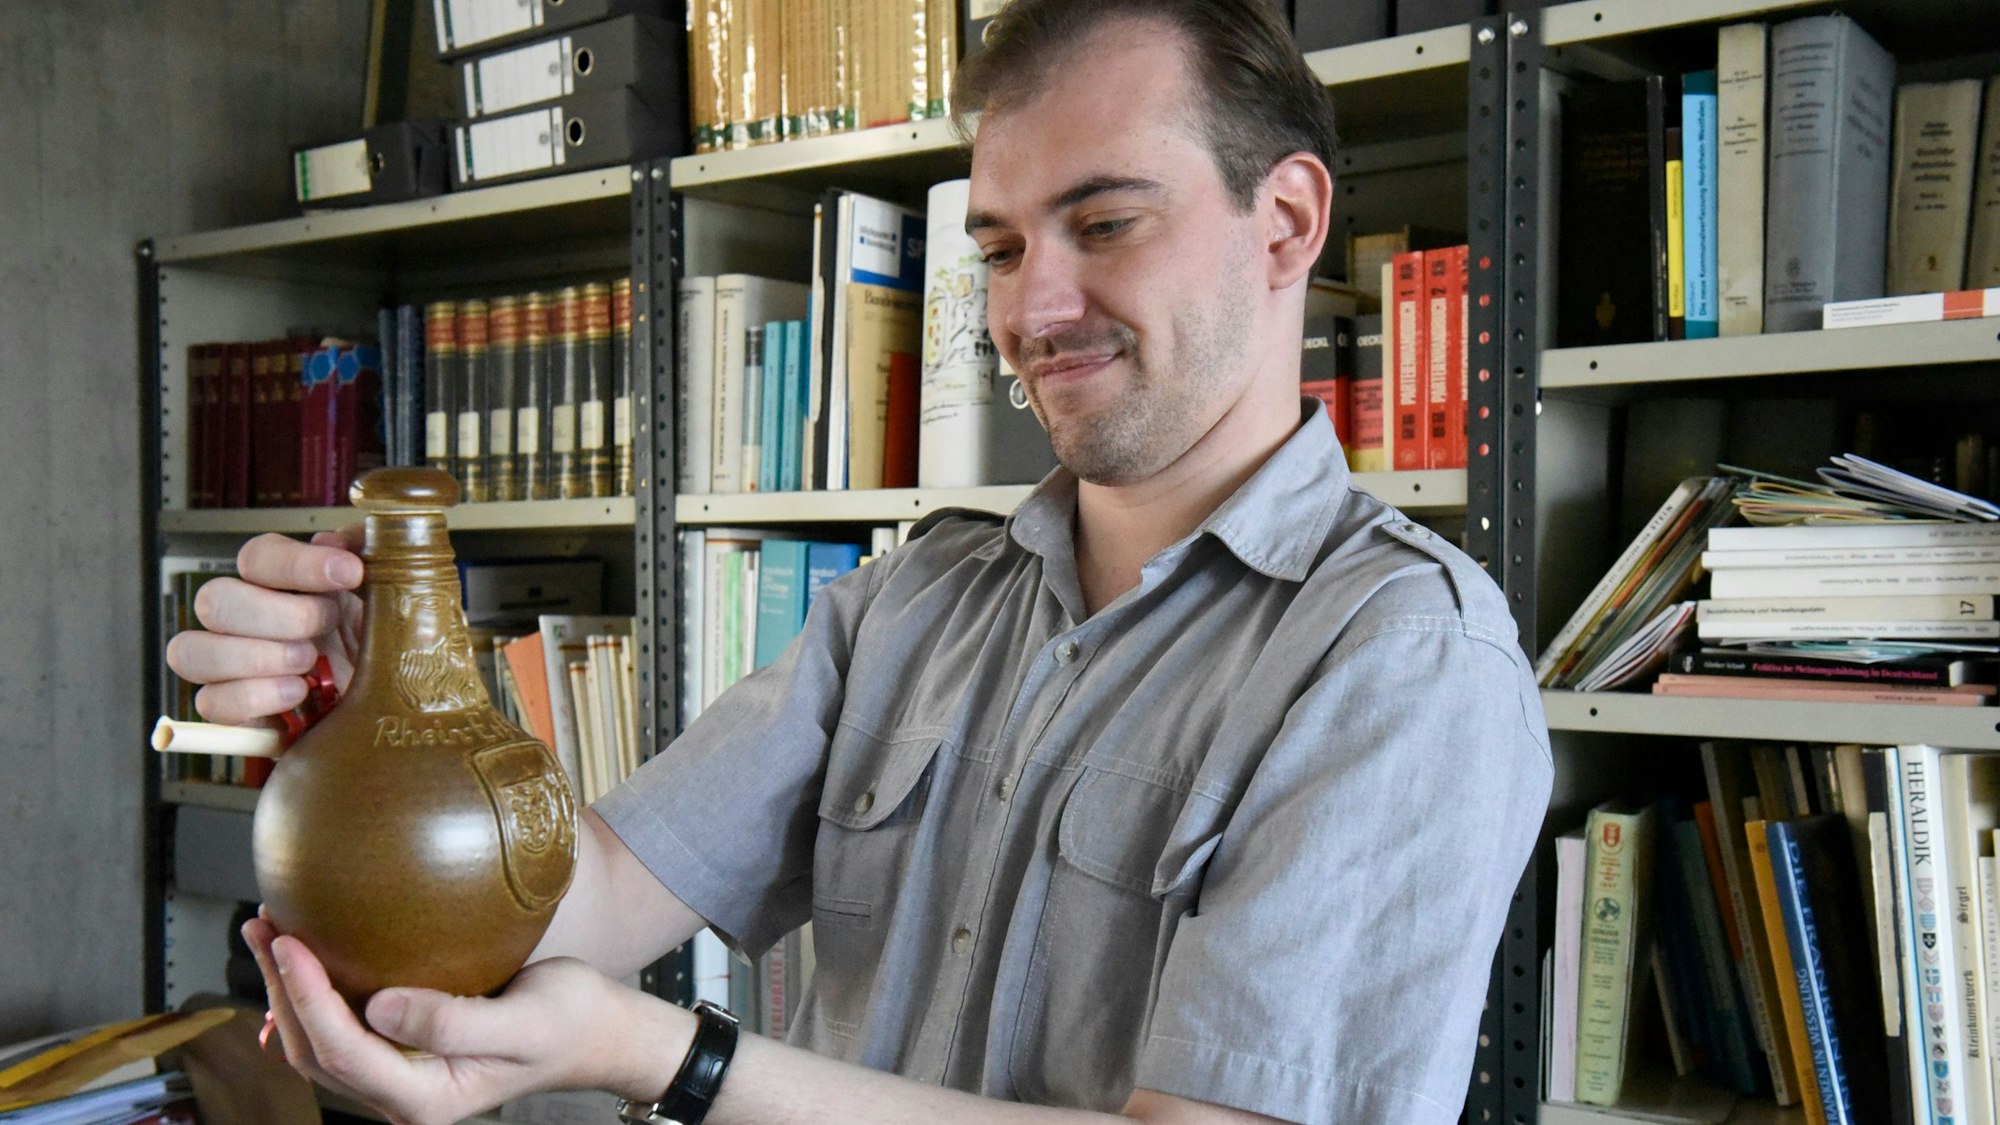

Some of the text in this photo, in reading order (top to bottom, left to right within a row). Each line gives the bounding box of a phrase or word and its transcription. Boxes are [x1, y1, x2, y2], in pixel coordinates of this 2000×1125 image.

[1697, 187, 1708, 278] Kommunalverfassung
[1699, 280, 1707, 300] neue
[1650, 503, 1673, 531] STEIN
[1959, 600, 1977, 617] 17
[1752, 662, 1794, 673] Politische
[1796, 665, 1870, 678] Meinungsbildung
[1881, 669, 1938, 681] Deutschland
[1907, 761, 1932, 866] HERALDIK
[1796, 967, 1822, 1047] WESSELING
[1963, 970, 1979, 1059] Kleinkunstwerk
[1813, 1050, 1827, 1065] IN
